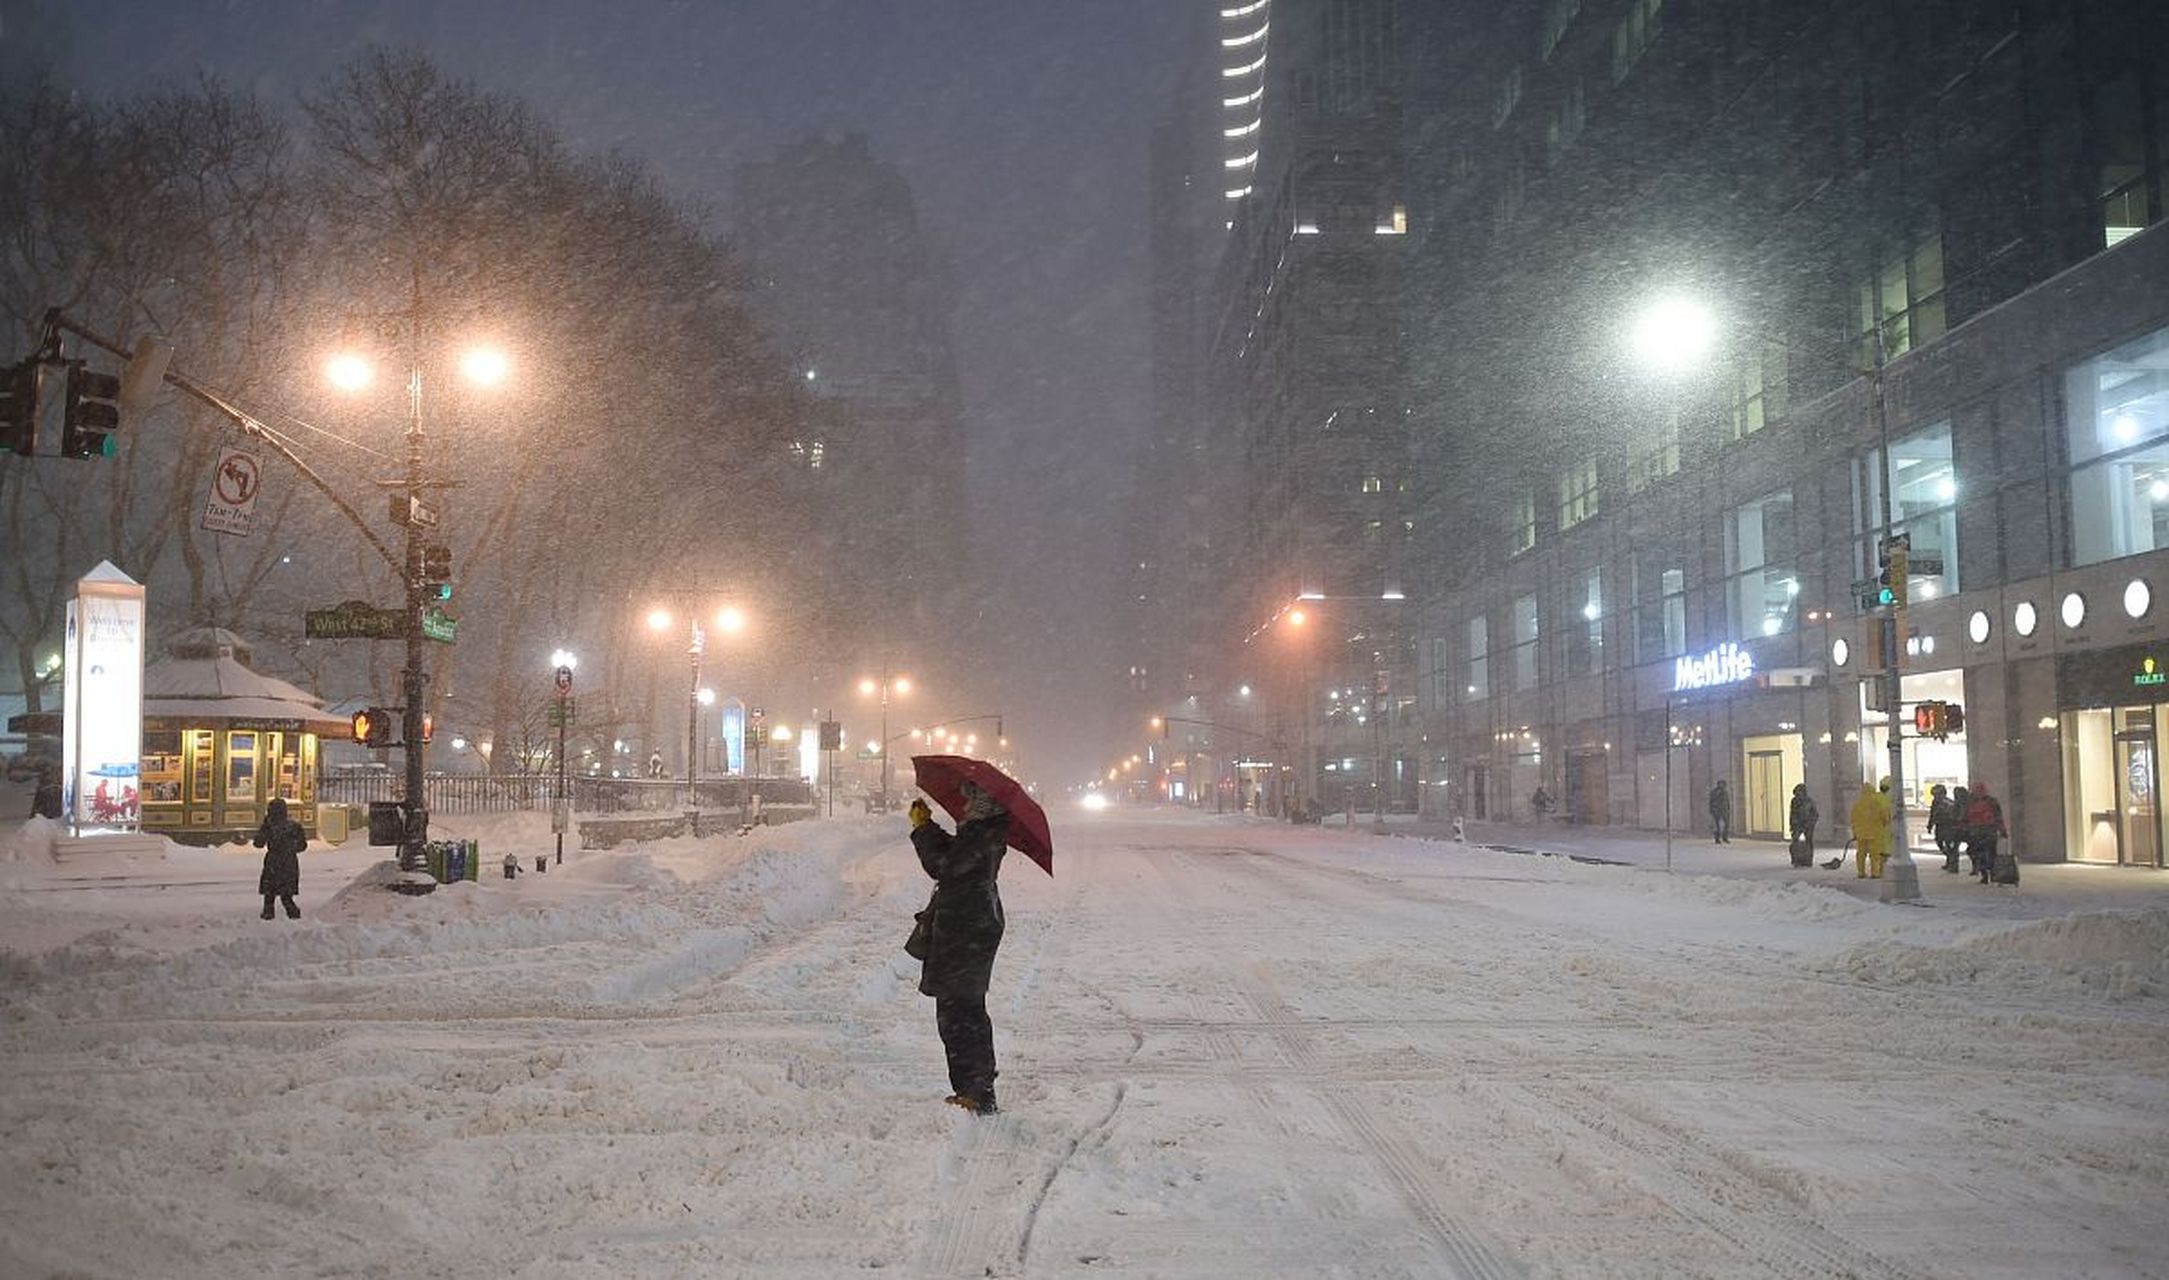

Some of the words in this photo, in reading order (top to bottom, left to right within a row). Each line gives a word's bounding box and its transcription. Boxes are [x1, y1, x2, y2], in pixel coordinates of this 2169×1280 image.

[315, 617, 347, 630] West
[380, 616, 394, 629] St
[1674, 642, 1753, 691] MetLife
[2134, 673, 2167, 686] ROLEX
